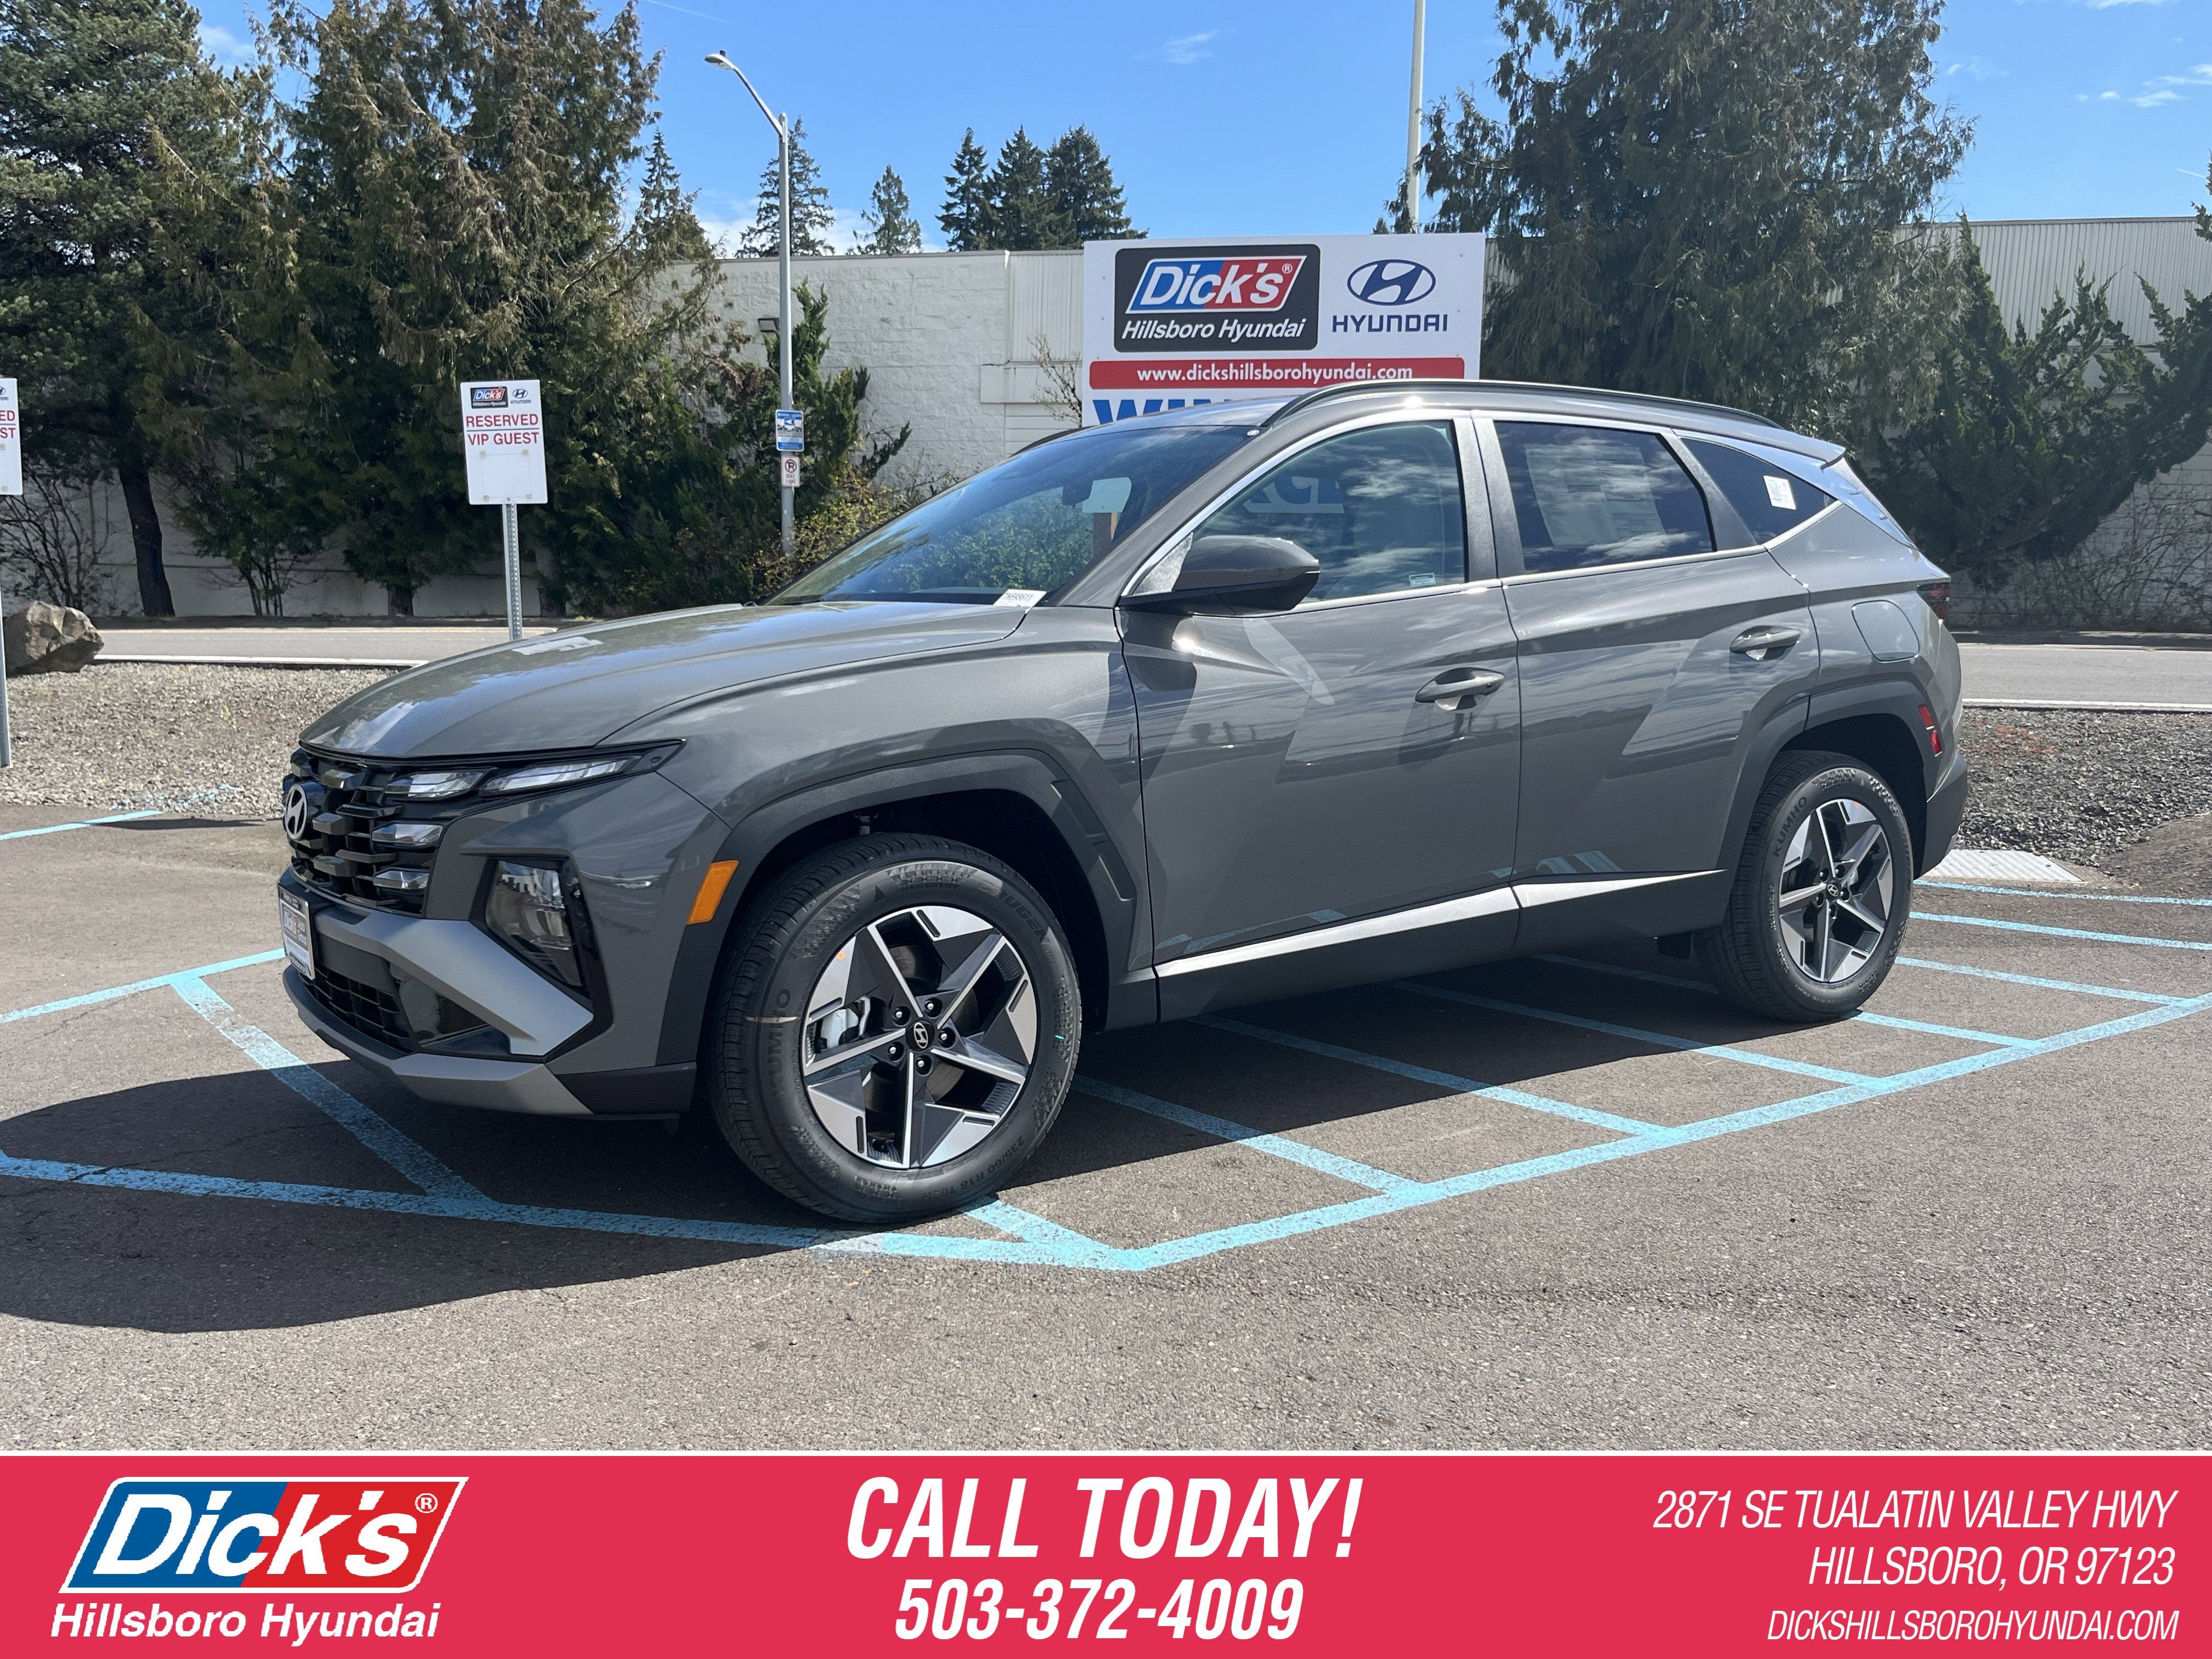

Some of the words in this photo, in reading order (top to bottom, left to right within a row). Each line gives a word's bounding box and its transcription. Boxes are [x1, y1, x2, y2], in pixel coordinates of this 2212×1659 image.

[1140, 263, 1284, 306] Dick's
[1122, 320, 1215, 339] Hillsboro
[1218, 318, 1307, 343] Hyundai
[1332, 314, 1448, 332] HYUNDAI
[1137, 363, 1413, 384] www.dickshillsborohyundai.com
[466, 414, 538, 427] RESERVED
[468, 434, 489, 445] VIP
[494, 432, 539, 445] GUEST
[1773, 796, 1807, 857] KUMHO
[768, 989, 791, 1096] KUMHO
